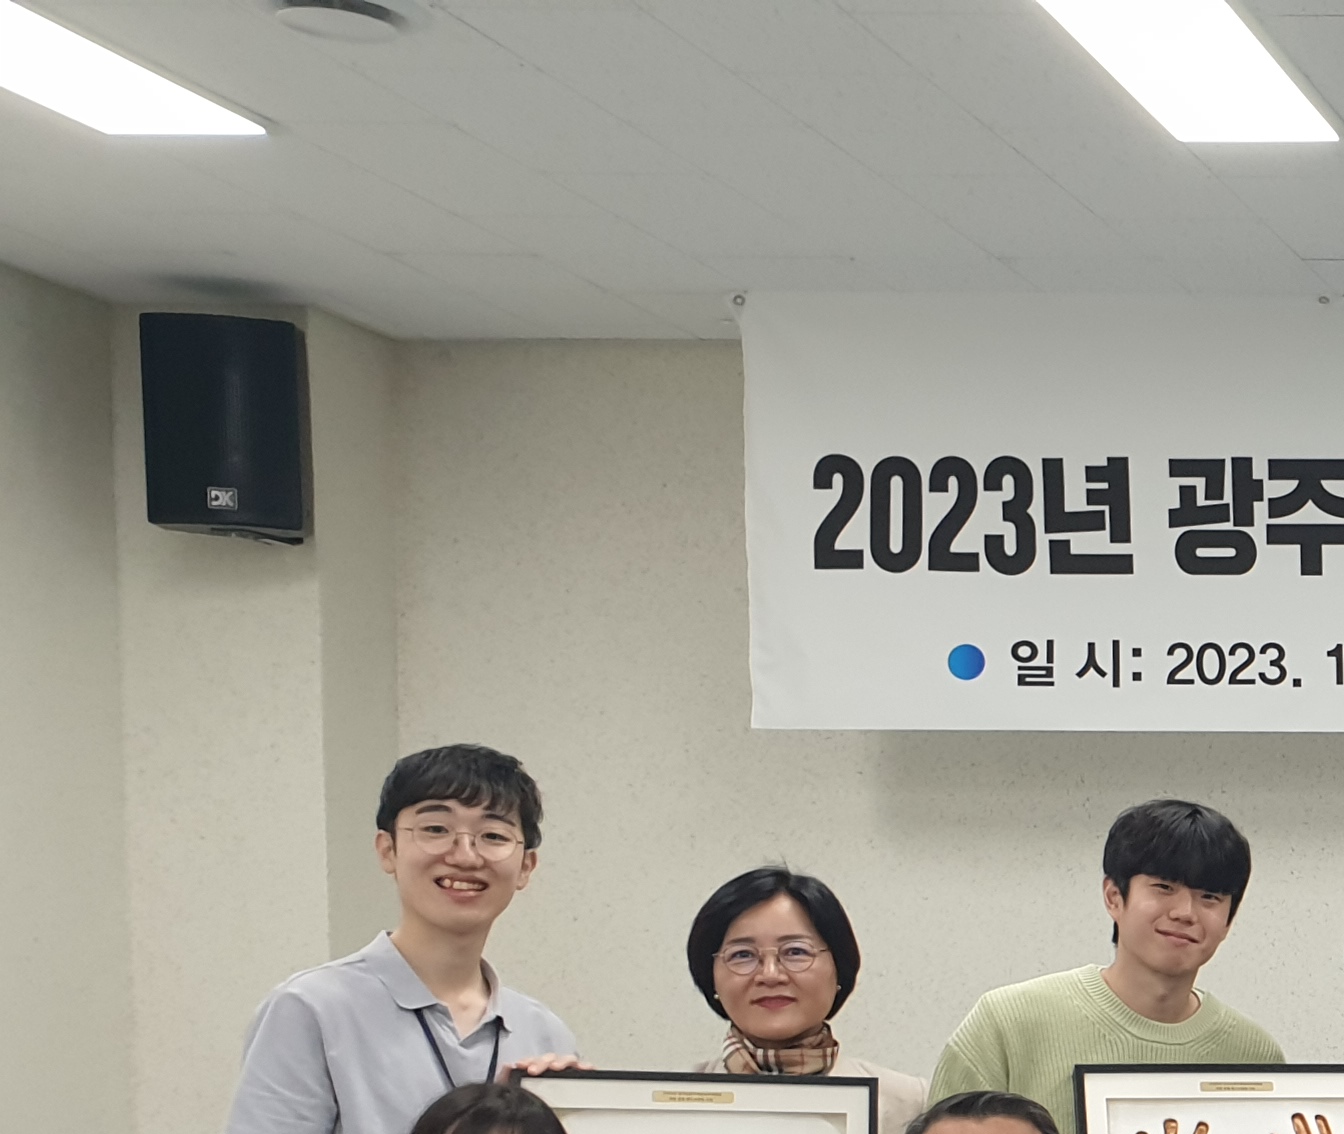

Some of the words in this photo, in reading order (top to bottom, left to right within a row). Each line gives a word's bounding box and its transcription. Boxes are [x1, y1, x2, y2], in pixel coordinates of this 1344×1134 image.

[813, 454, 1134, 576] 2023년
[1011, 639, 1055, 686] 일
[1076, 640, 1142, 688] 시:
[1167, 642, 1301, 687] 2023.
